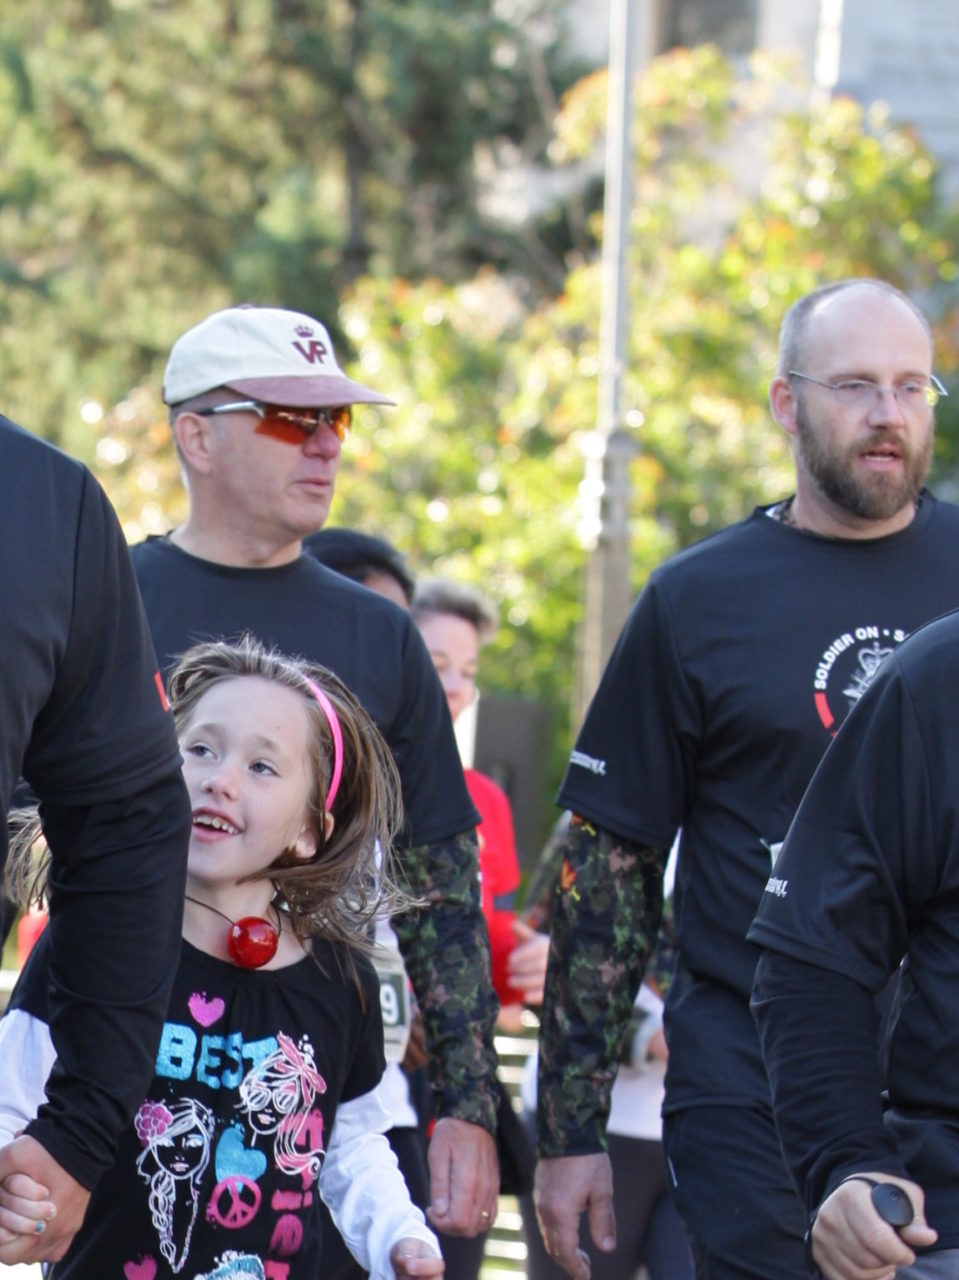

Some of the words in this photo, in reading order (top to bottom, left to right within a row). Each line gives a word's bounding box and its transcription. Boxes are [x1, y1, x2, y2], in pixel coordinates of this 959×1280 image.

[814, 633, 855, 690] SOLDIER
[855, 626, 879, 641] ON
[155, 1022, 279, 1090] BEST
